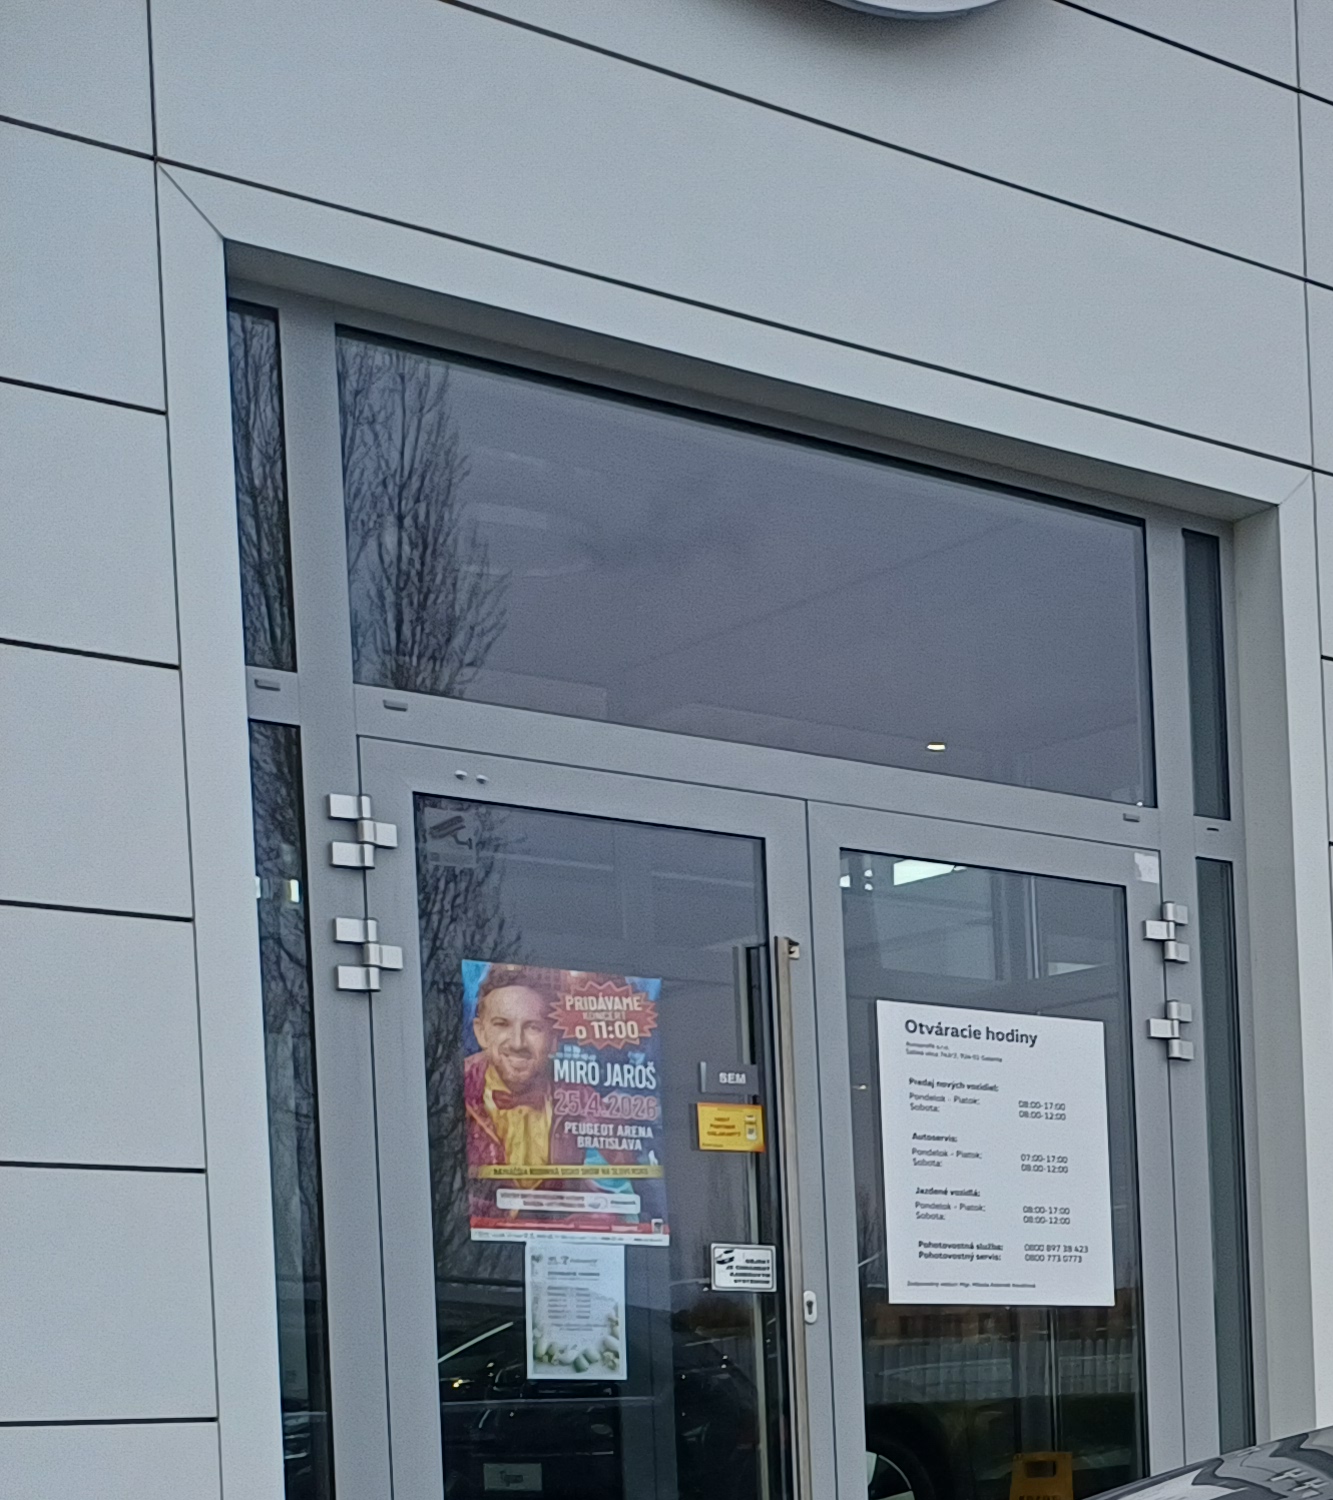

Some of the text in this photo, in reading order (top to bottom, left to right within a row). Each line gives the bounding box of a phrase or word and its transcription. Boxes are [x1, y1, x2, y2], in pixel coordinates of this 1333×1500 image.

[565, 992, 642, 1011] PRIDÁVAME
[590, 1020, 639, 1039] 11:00
[905, 1019, 1038, 1048] Otváracie hodiny
[554, 1059, 656, 1090] MIRO JAROŠ
[719, 1072, 746, 1084] SEM
[909, 1077, 934, 1088] Predaj
[936, 1081, 965, 1090] nových
[553, 1087, 658, 1120] 25.4.2026
[564, 1121, 655, 1139] PEUGEOT ARENA
[577, 1136, 642, 1151] BRATISLAVA
[1020, 1153, 1068, 1164] 07:00-17:00
